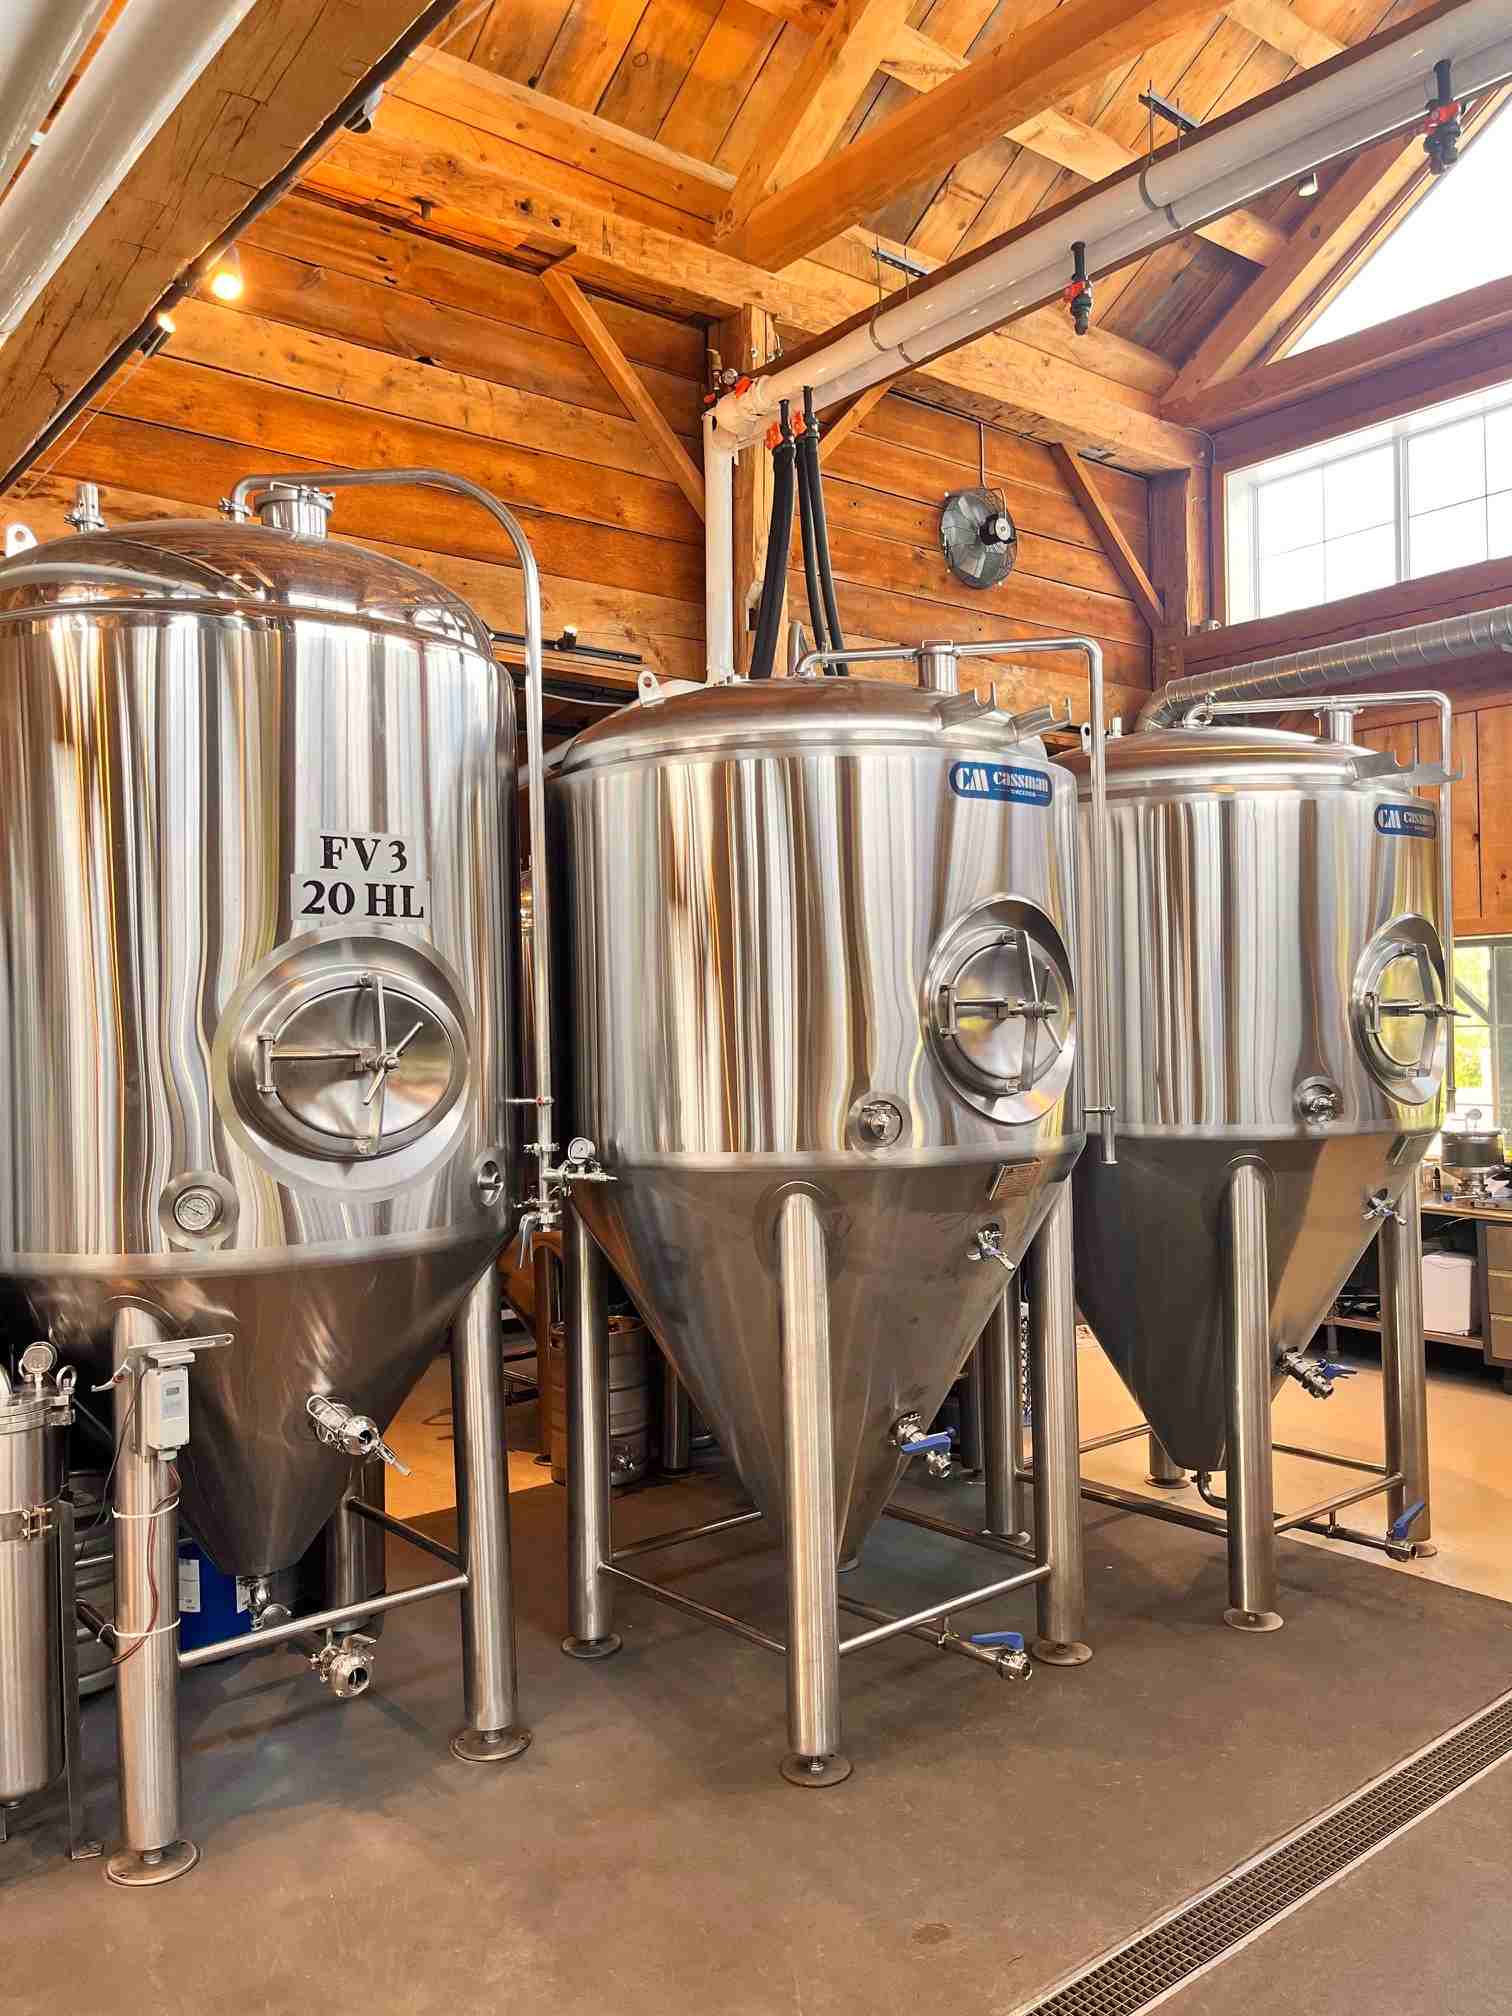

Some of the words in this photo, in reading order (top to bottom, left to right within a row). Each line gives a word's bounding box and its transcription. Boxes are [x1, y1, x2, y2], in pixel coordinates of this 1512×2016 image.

[957, 767, 989, 792] CM
[301, 880, 355, 915] 20
[364, 883, 424, 919] HL
